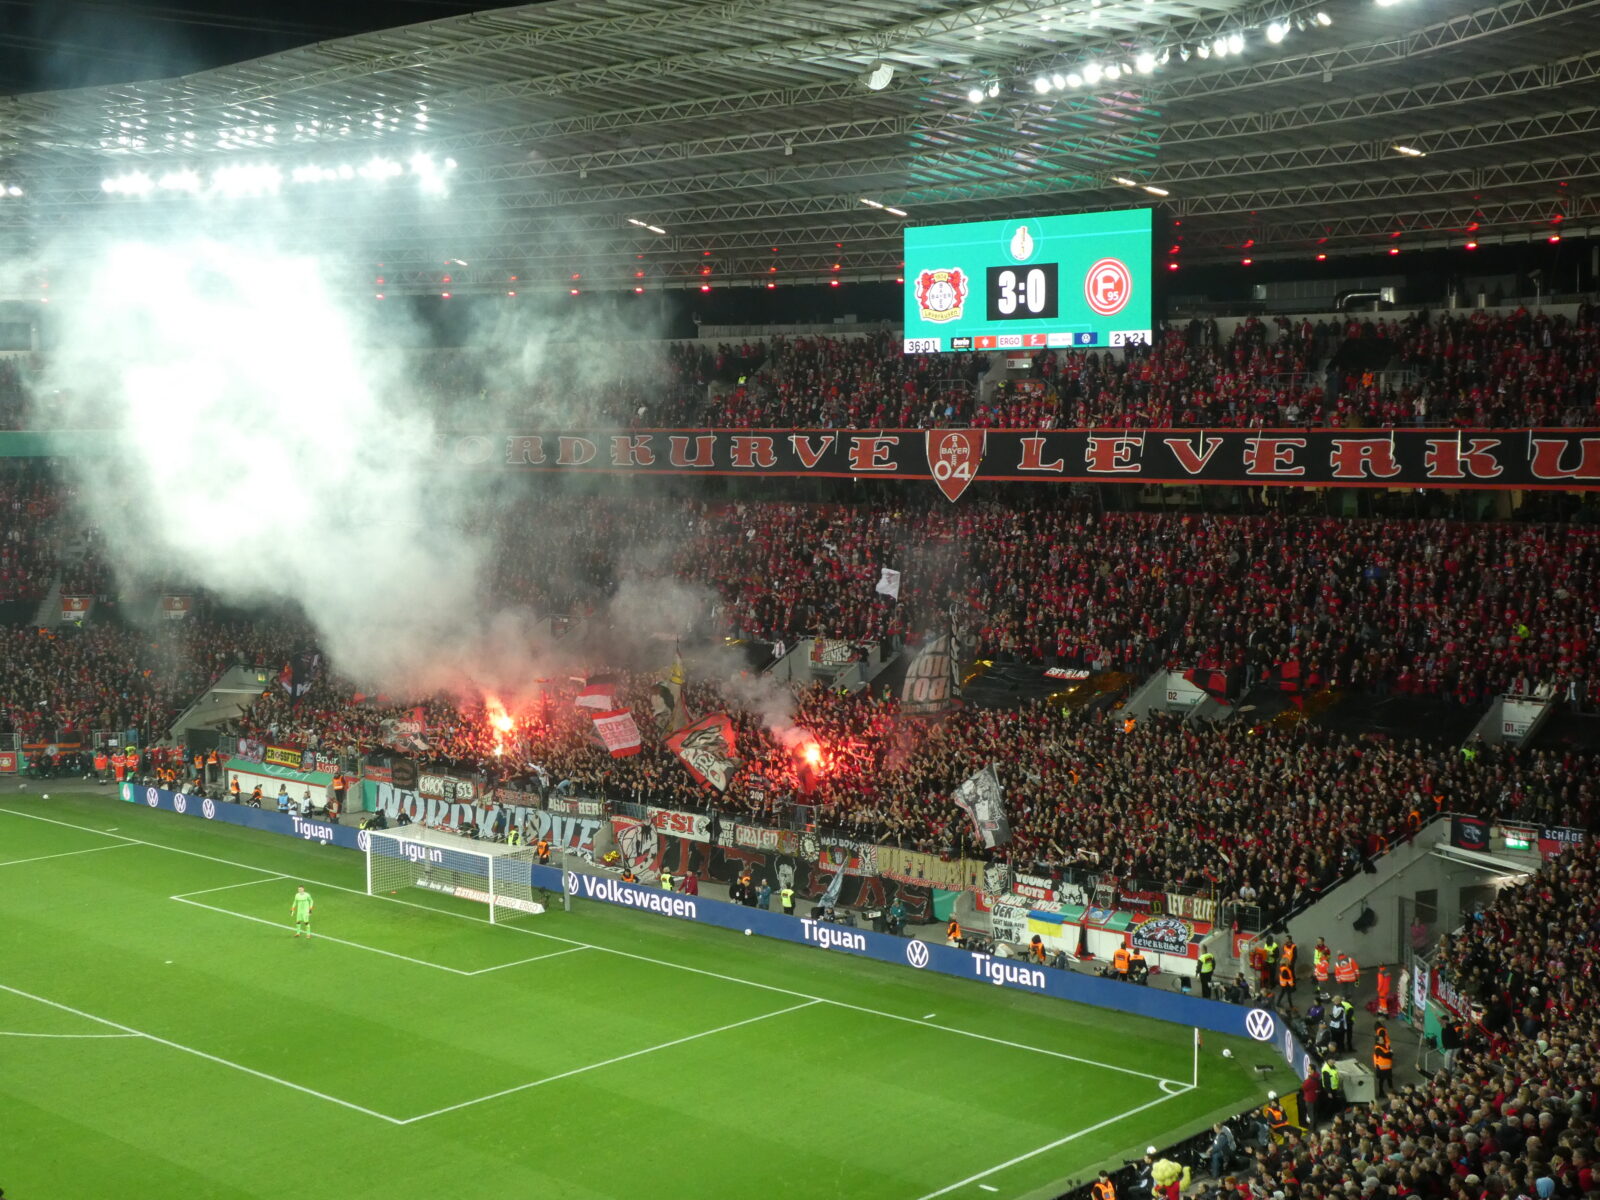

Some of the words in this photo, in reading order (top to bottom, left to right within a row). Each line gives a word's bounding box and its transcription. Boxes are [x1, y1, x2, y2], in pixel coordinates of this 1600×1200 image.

[998, 269, 1046, 315] 3:0
[1107, 291, 1119, 301] 95
[908, 340, 936, 352] 36:01
[1000, 337, 1020, 346] ERGO
[941, 447, 968, 455] BAYER
[934, 460, 971, 481] 04
[292, 816, 333, 840] Tiguan
[1015, 873, 1052, 890] YOUNG
[582, 874, 697, 918] Volkswagen
[519, 901, 538, 912] ERGO
[800, 918, 866, 951] Tiguan
[1133, 937, 1186, 954] LEVERKUSEN
[971, 952, 1046, 989] Tiguan
